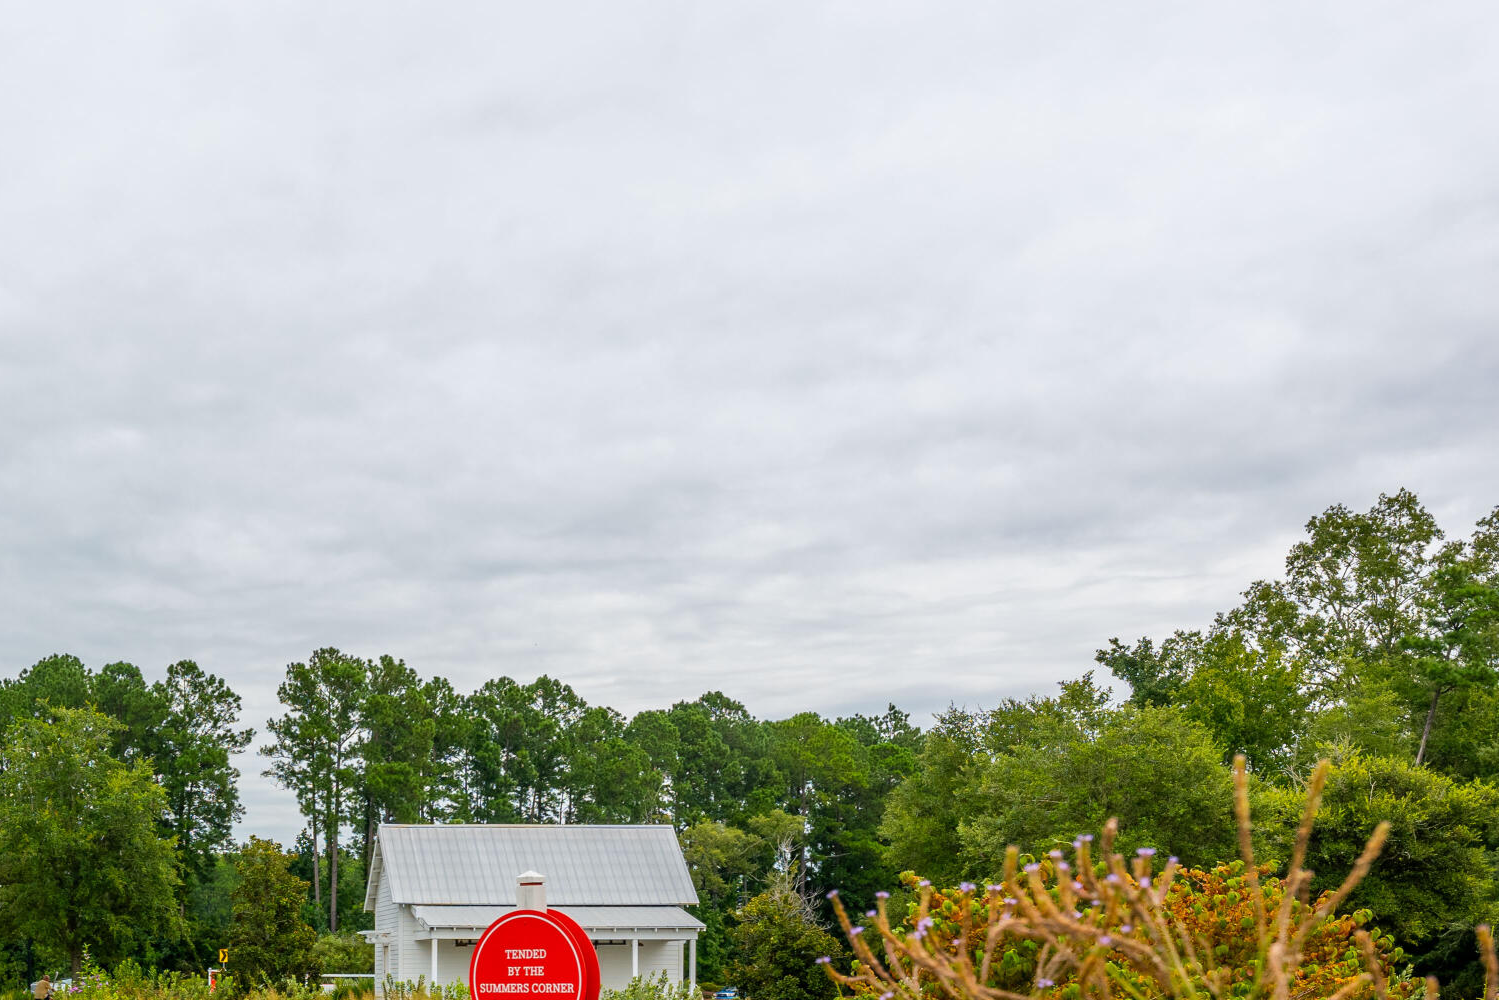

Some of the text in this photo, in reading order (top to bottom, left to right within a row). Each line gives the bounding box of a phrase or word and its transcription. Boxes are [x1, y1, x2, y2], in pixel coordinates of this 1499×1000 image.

[505, 949, 547, 959] TENDED
[507, 966, 544, 976] BY THE
[480, 983, 575, 993] SUMMERS CORNER
